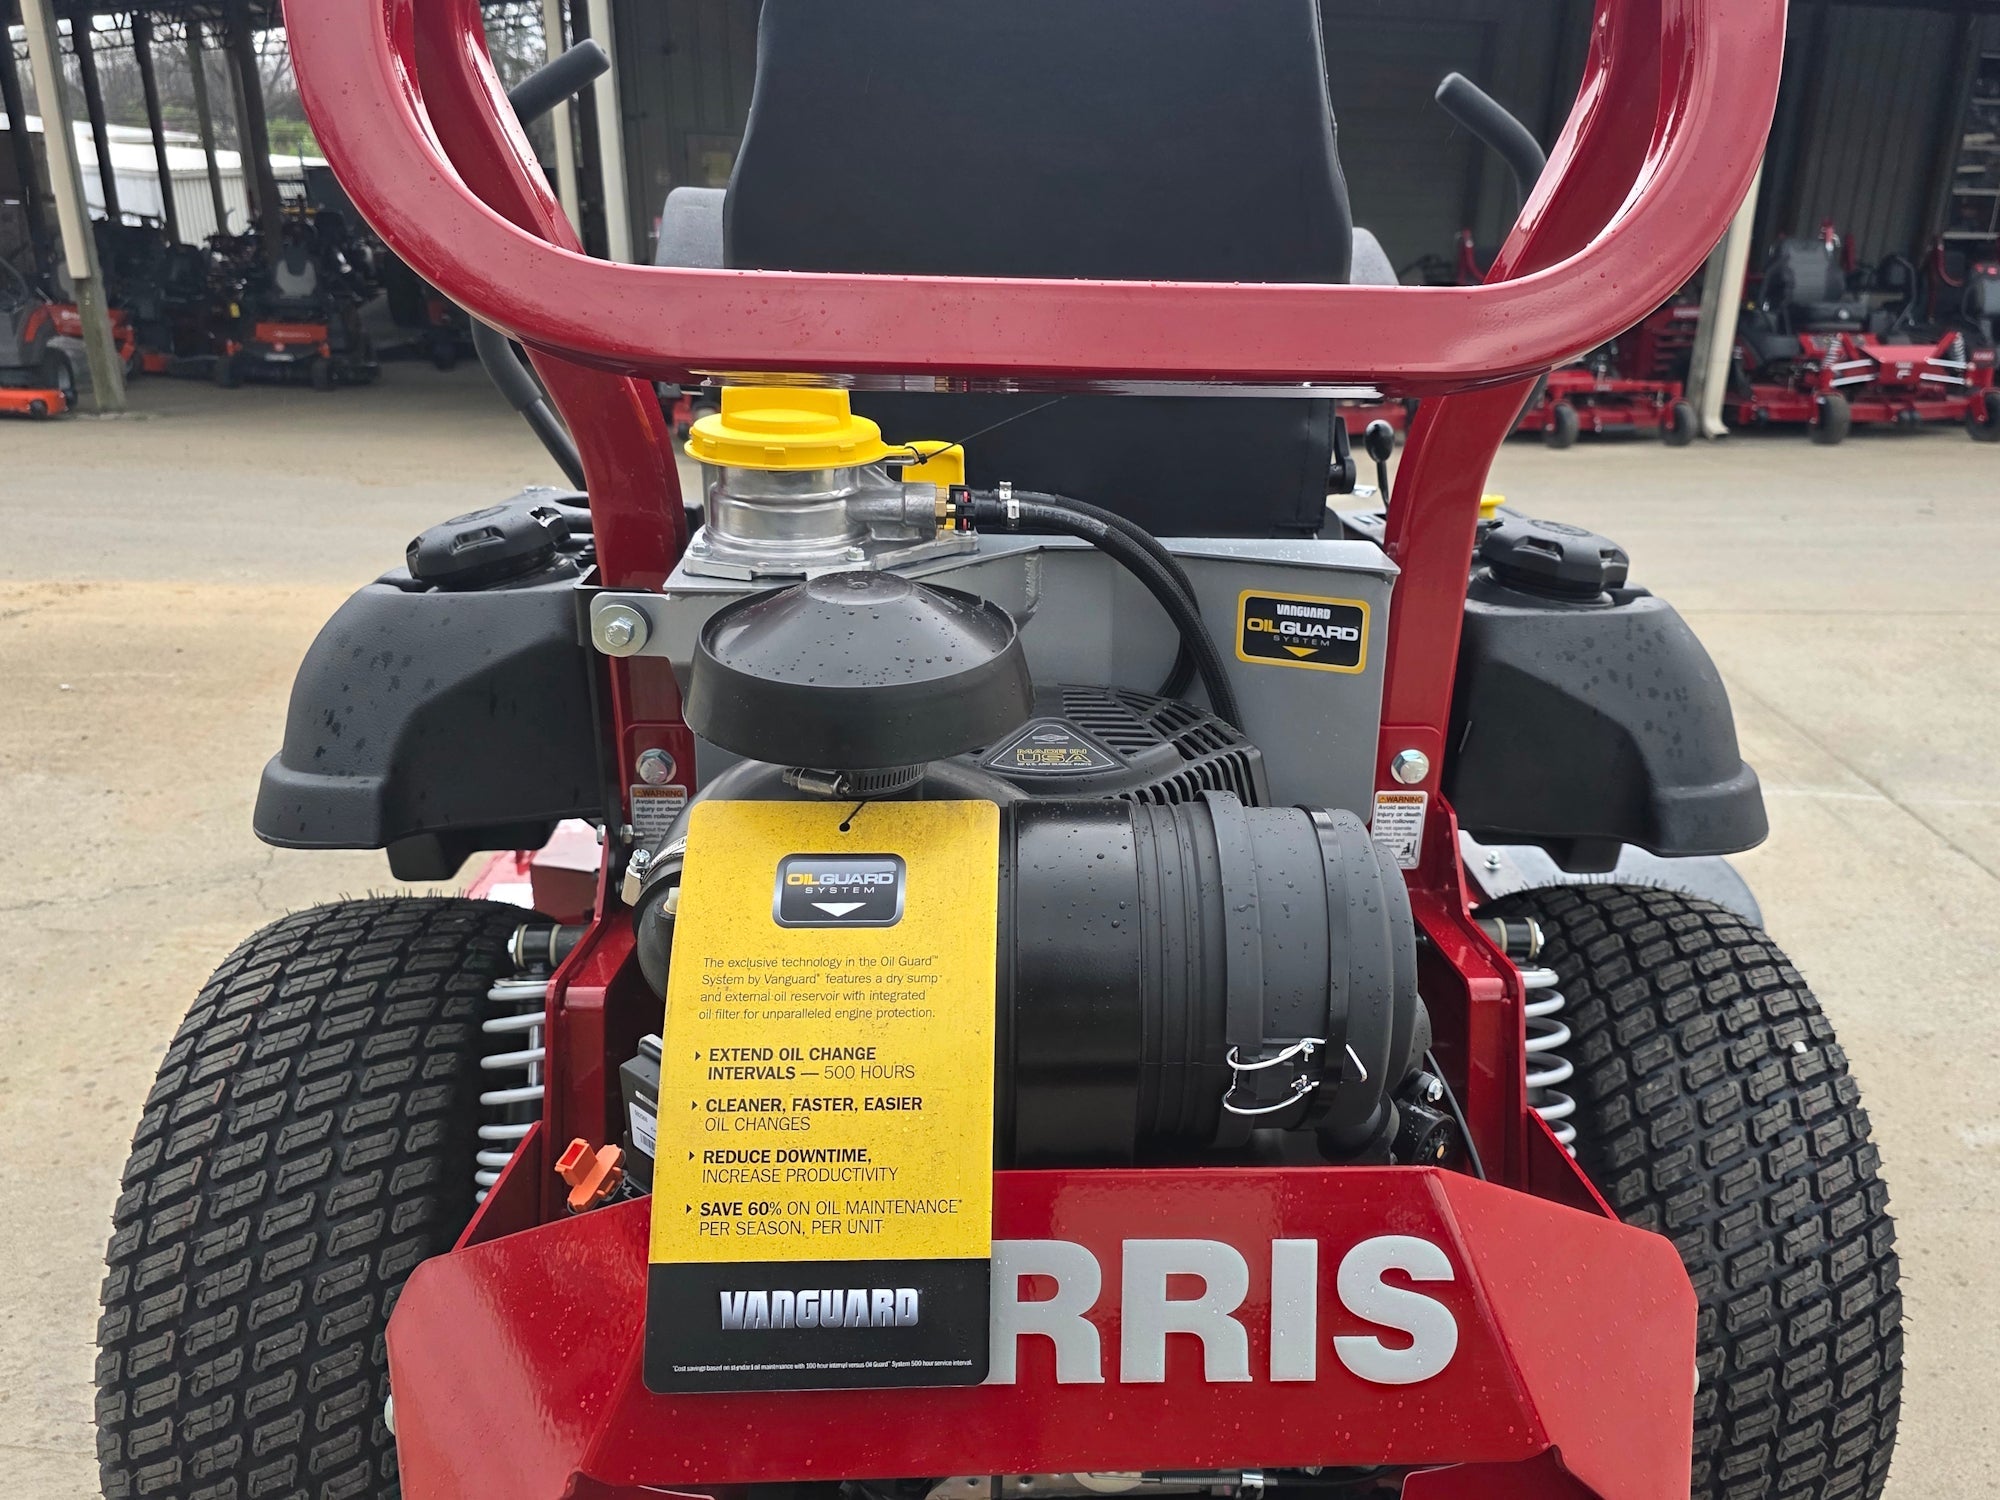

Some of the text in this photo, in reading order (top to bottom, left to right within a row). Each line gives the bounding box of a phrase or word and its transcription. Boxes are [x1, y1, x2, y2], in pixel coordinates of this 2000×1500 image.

[1277, 604, 1331, 620] VANGUARD
[1273, 636, 1330, 646] SYSTEM
[1017, 754, 1091, 762] USA
[787, 871, 894, 885] OILGUARD
[805, 886, 875, 894] SYSTEM
[704, 958, 724, 968] The
[728, 958, 778, 968] exclusive
[782, 957, 842, 969] technology
[845, 957, 855, 967] in
[859, 956, 877, 966] the
[880, 956, 895, 966] Oil
[702, 974, 744, 986] System
[748, 974, 760, 986] by
[825, 973, 872, 984] features
[875, 976, 882, 984] a
[886, 973, 903, 986] dry
[907, 975, 938, 986] sump
[700, 990, 926, 1002] and external oil reservoir with integrated
[699, 1008, 935, 1021] oil filter for unparalleled engine protection.
[709, 1047, 876, 1062] EXTEND OIL CHANGE
[708, 1066, 796, 1080] INTERVALS
[824, 1066, 855, 1079] 500
[861, 1065, 915, 1079] HOURS
[706, 1097, 922, 1113] CLEANER, FASTER, EASIER
[704, 1117, 811, 1131] OIL CHANGES
[703, 1149, 872, 1164] REDUCE DOWNTIME,
[702, 1167, 898, 1183] INCREASE PRODUCTIVITY
[700, 1202, 743, 1216] SAVE
[748, 1201, 782, 1216] 60%
[787, 1201, 810, 1215] ON
[816, 1201, 840, 1214] OIL
[699, 1219, 883, 1236] PER SEASON, PER UNIT
[719, 1288, 920, 1330] VANGUARD
[990, 1235, 1458, 1385] RRIS
